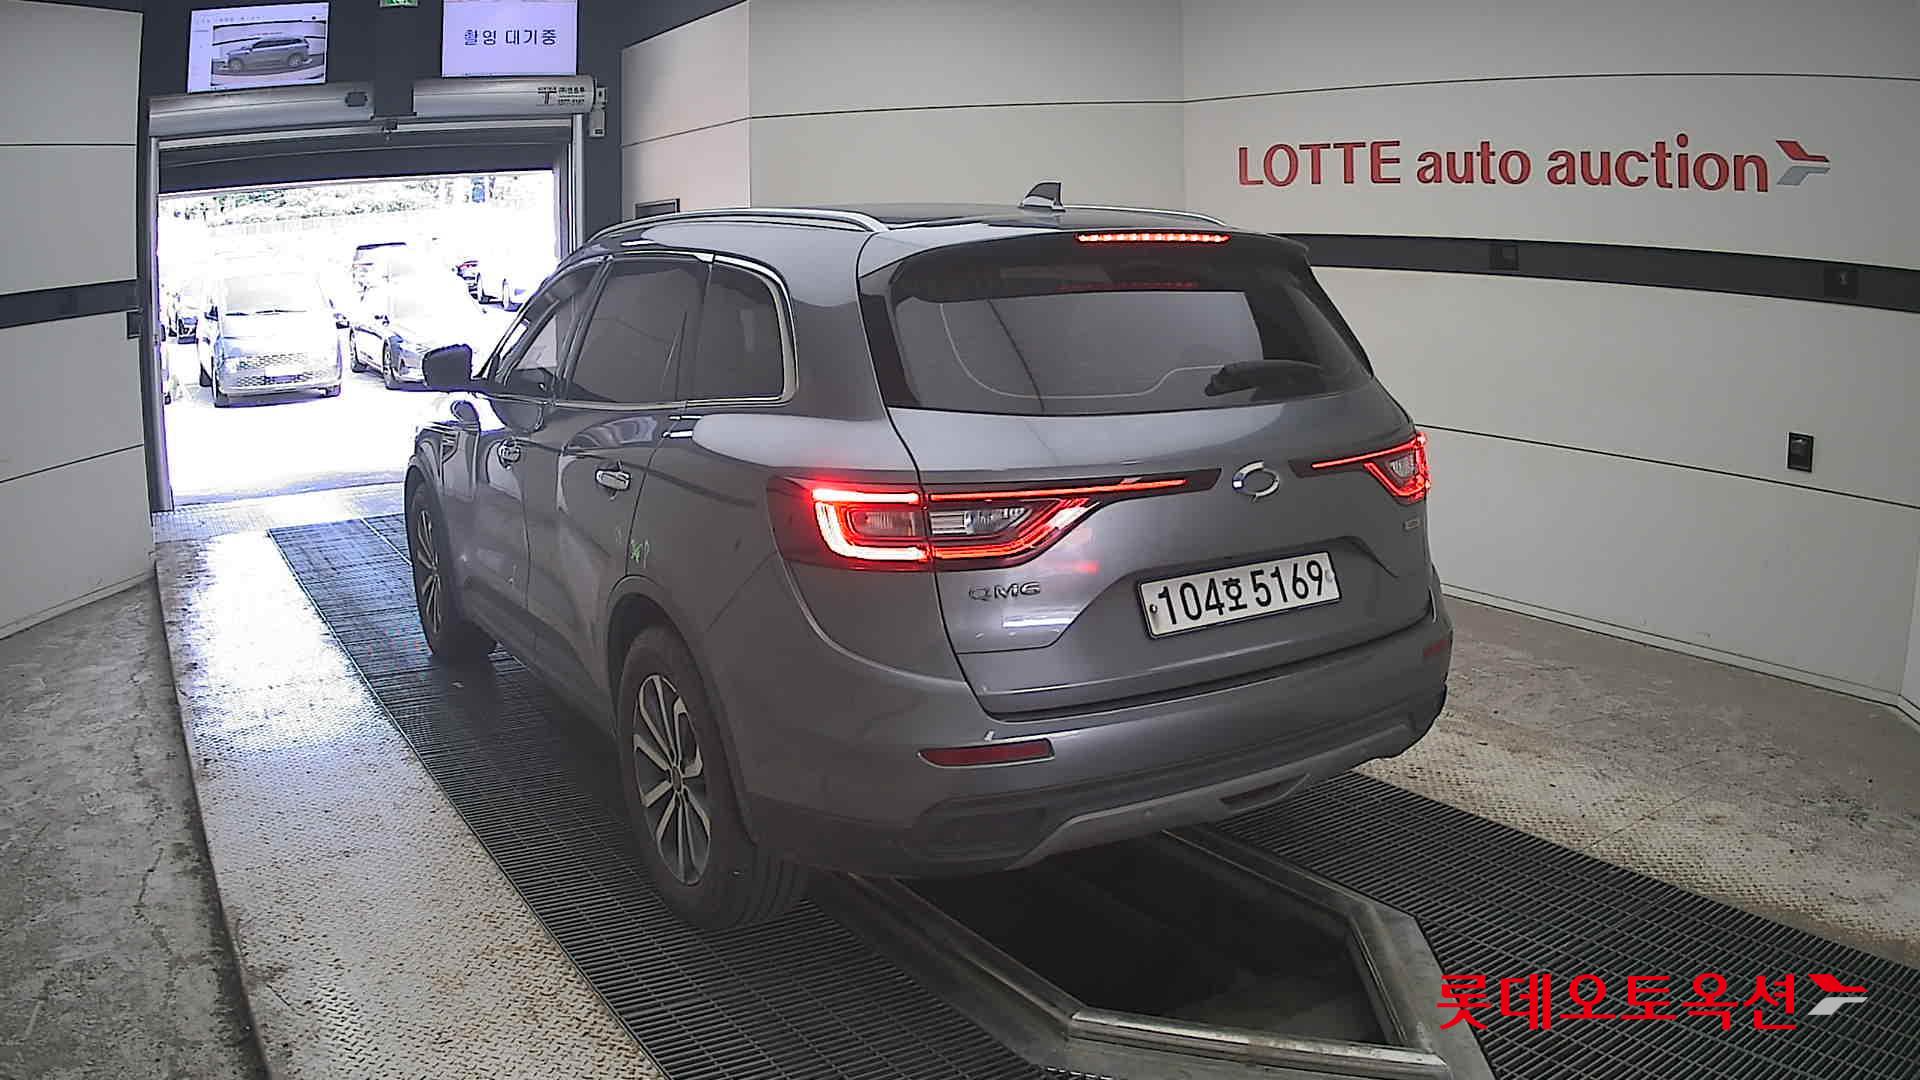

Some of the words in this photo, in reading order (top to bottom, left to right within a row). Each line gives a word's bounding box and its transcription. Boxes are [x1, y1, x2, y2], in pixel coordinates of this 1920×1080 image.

[505, 29, 557, 46] 대기중
[1238, 140, 1400, 187] LOTTE
[1416, 140, 1532, 186] auto
[1546, 133, 1769, 193] auction
[1157, 577, 1248, 626] 104호
[1249, 559, 1324, 608] 5169
